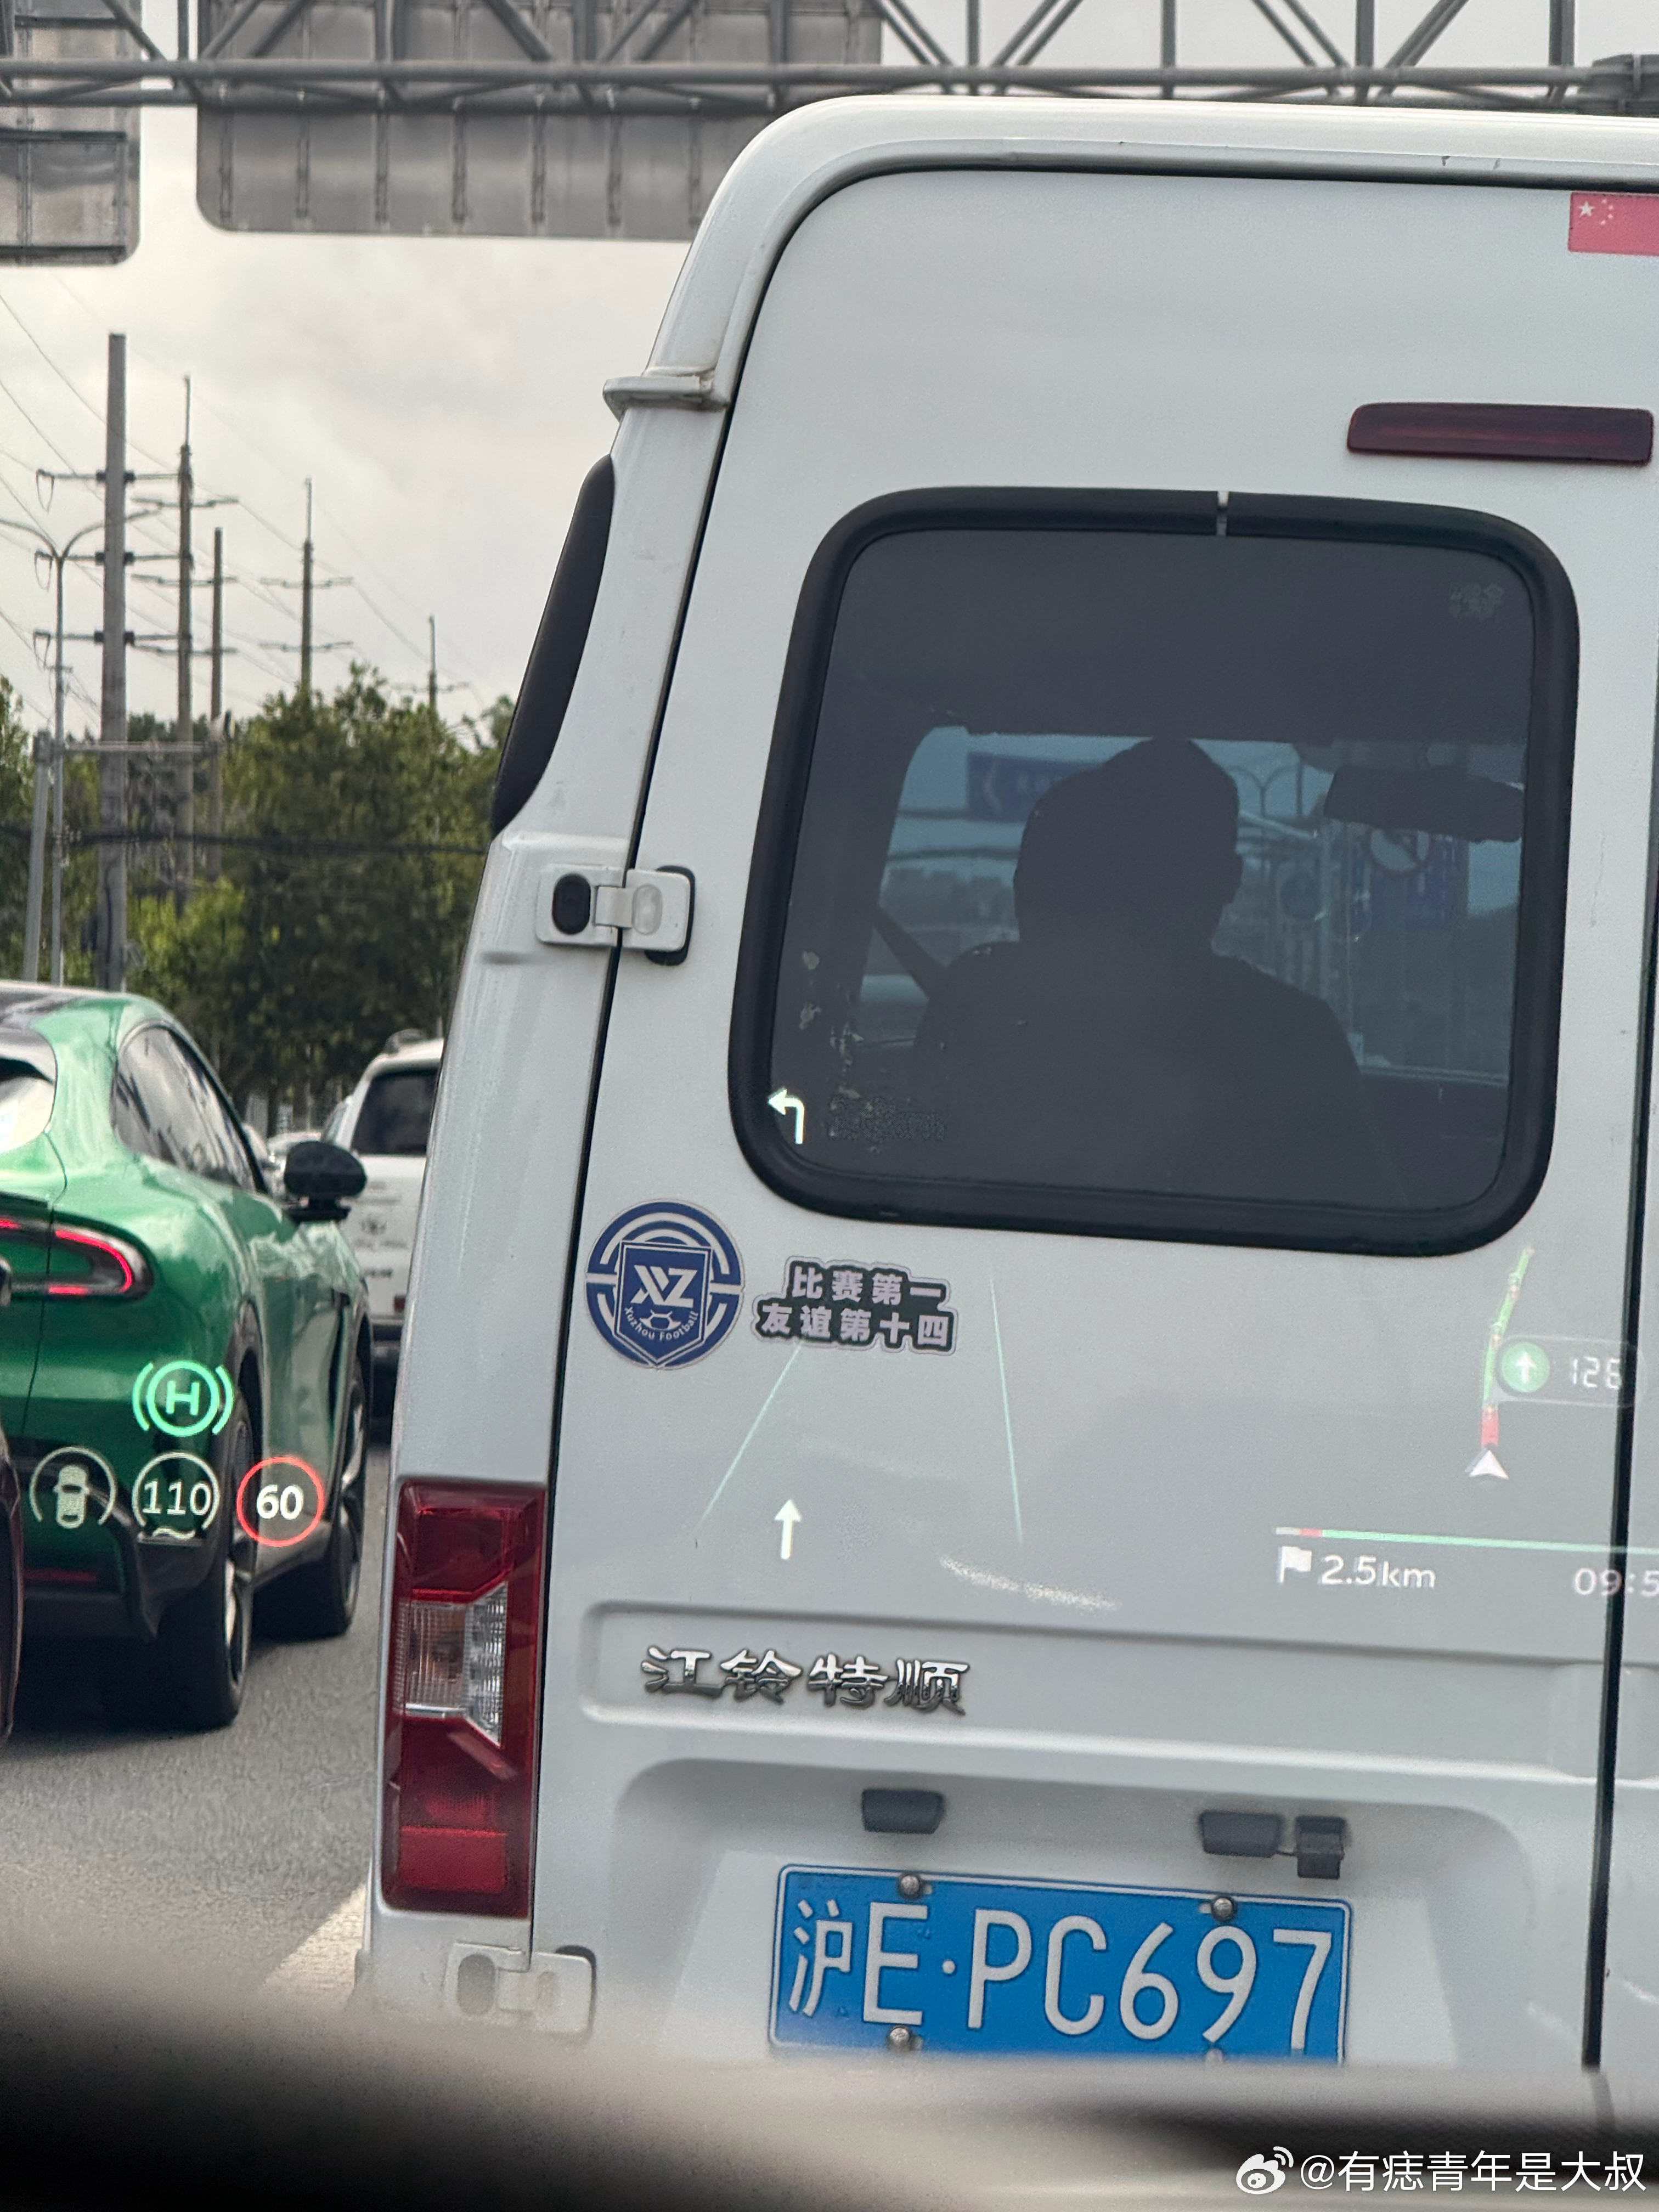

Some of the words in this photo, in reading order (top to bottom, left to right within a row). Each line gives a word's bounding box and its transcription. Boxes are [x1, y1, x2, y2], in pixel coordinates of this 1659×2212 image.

[791, 1265, 941, 1305] 比赛第一
[624, 1306, 656, 1340] Xuzhou
[659, 1310, 699, 1341] Football
[761, 1302, 949, 1347] 友谊第十四
[143, 1479, 212, 1516] 110
[256, 1484, 304, 1520] 60
[1320, 1554, 1436, 1590] 2.5km
[641, 1645, 970, 1716] 江铃特顺
